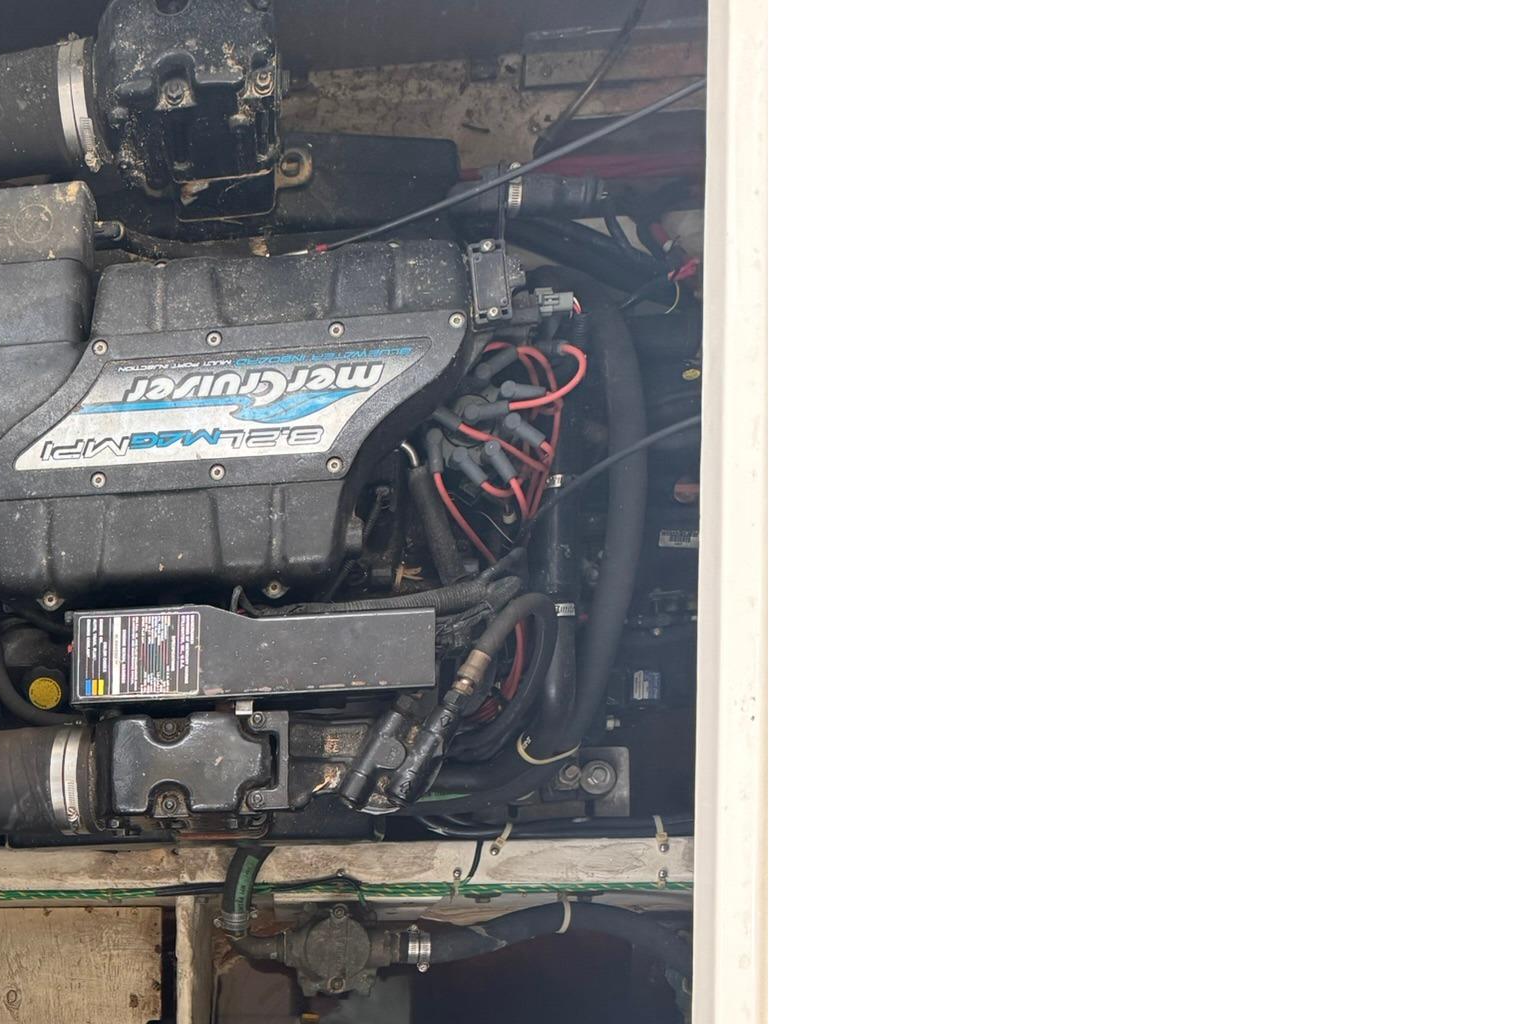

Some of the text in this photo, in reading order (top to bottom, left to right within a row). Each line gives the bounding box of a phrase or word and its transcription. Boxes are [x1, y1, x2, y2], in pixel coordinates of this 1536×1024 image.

[234, 354, 305, 366] INBOARD
[312, 347, 413, 362] BLUEWATER
[117, 364, 169, 372] INJECTION
